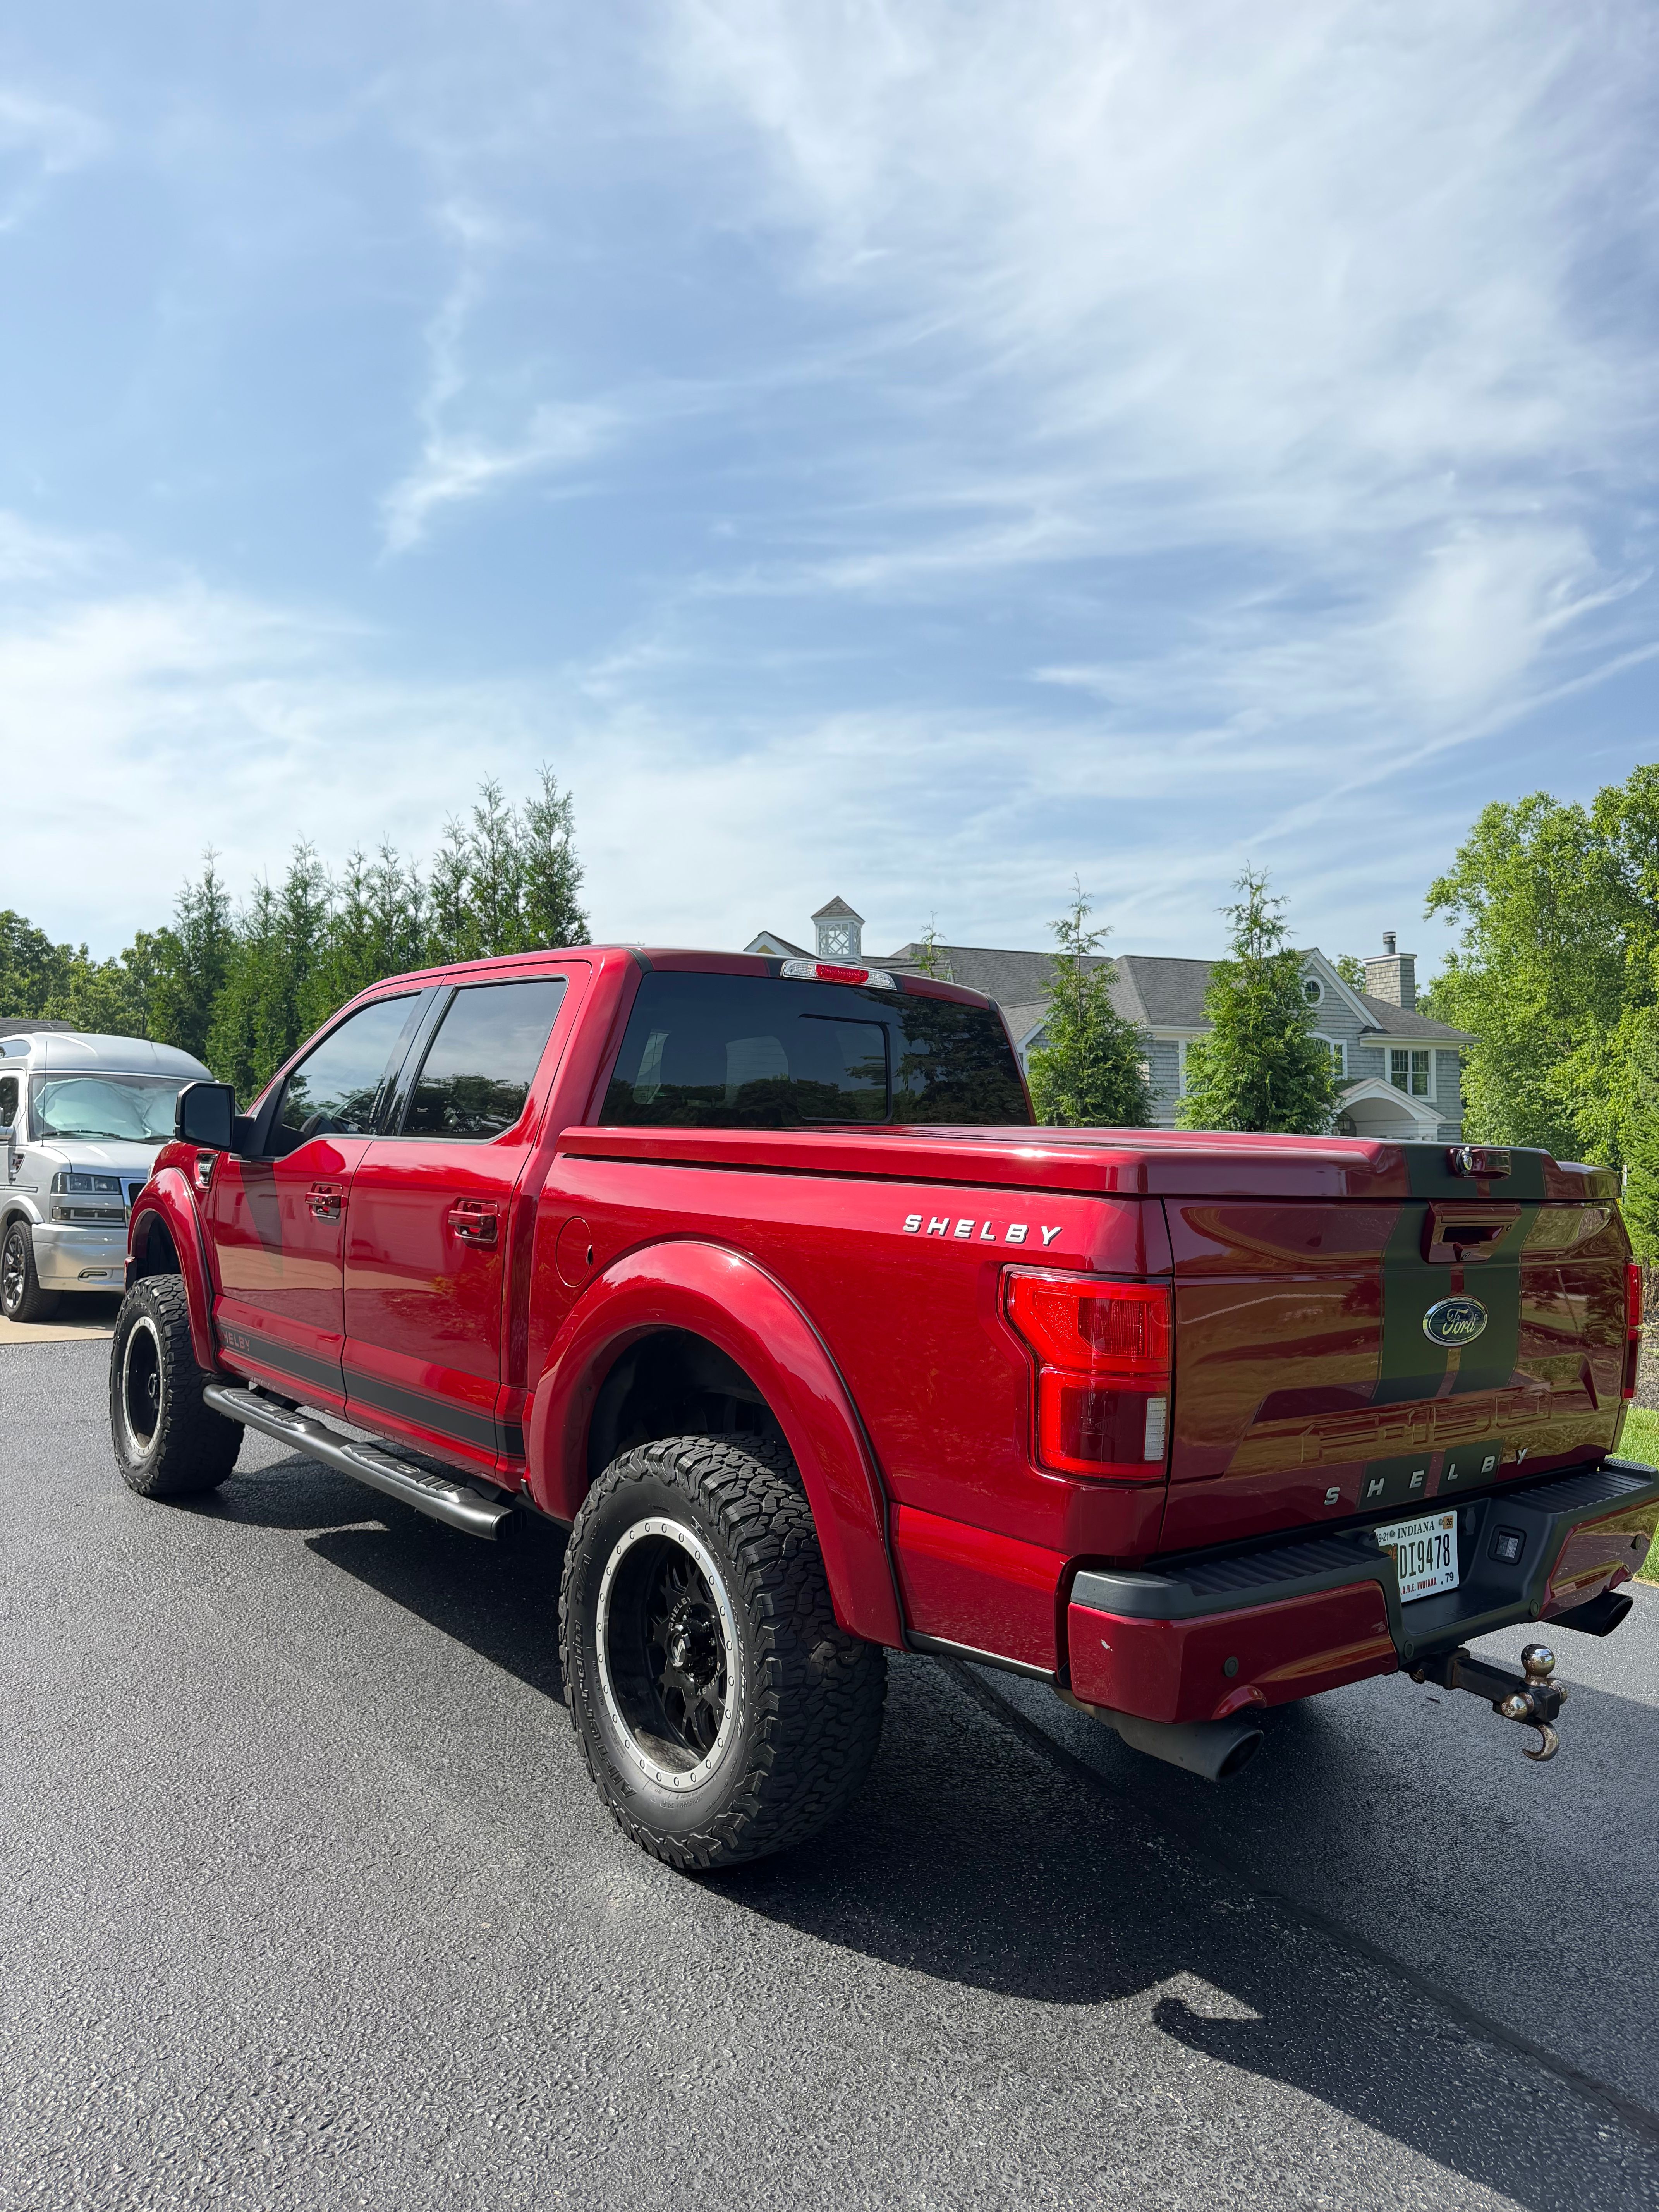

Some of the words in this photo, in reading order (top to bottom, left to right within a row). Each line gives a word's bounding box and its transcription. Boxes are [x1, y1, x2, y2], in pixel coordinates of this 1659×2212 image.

[903, 1214, 1063, 1247] SHELBY
[1442, 1308, 1478, 1335] Ford
[1324, 1448, 1528, 1506] SHELBY
[1397, 1520, 1435, 1539] INDIANA
[1400, 1533, 1450, 1579] DI9478
[1417, 1577, 1437, 1590] INDIANA
[1445, 1571, 1454, 1583] 79
[668, 1595, 692, 1631] SHELBY
